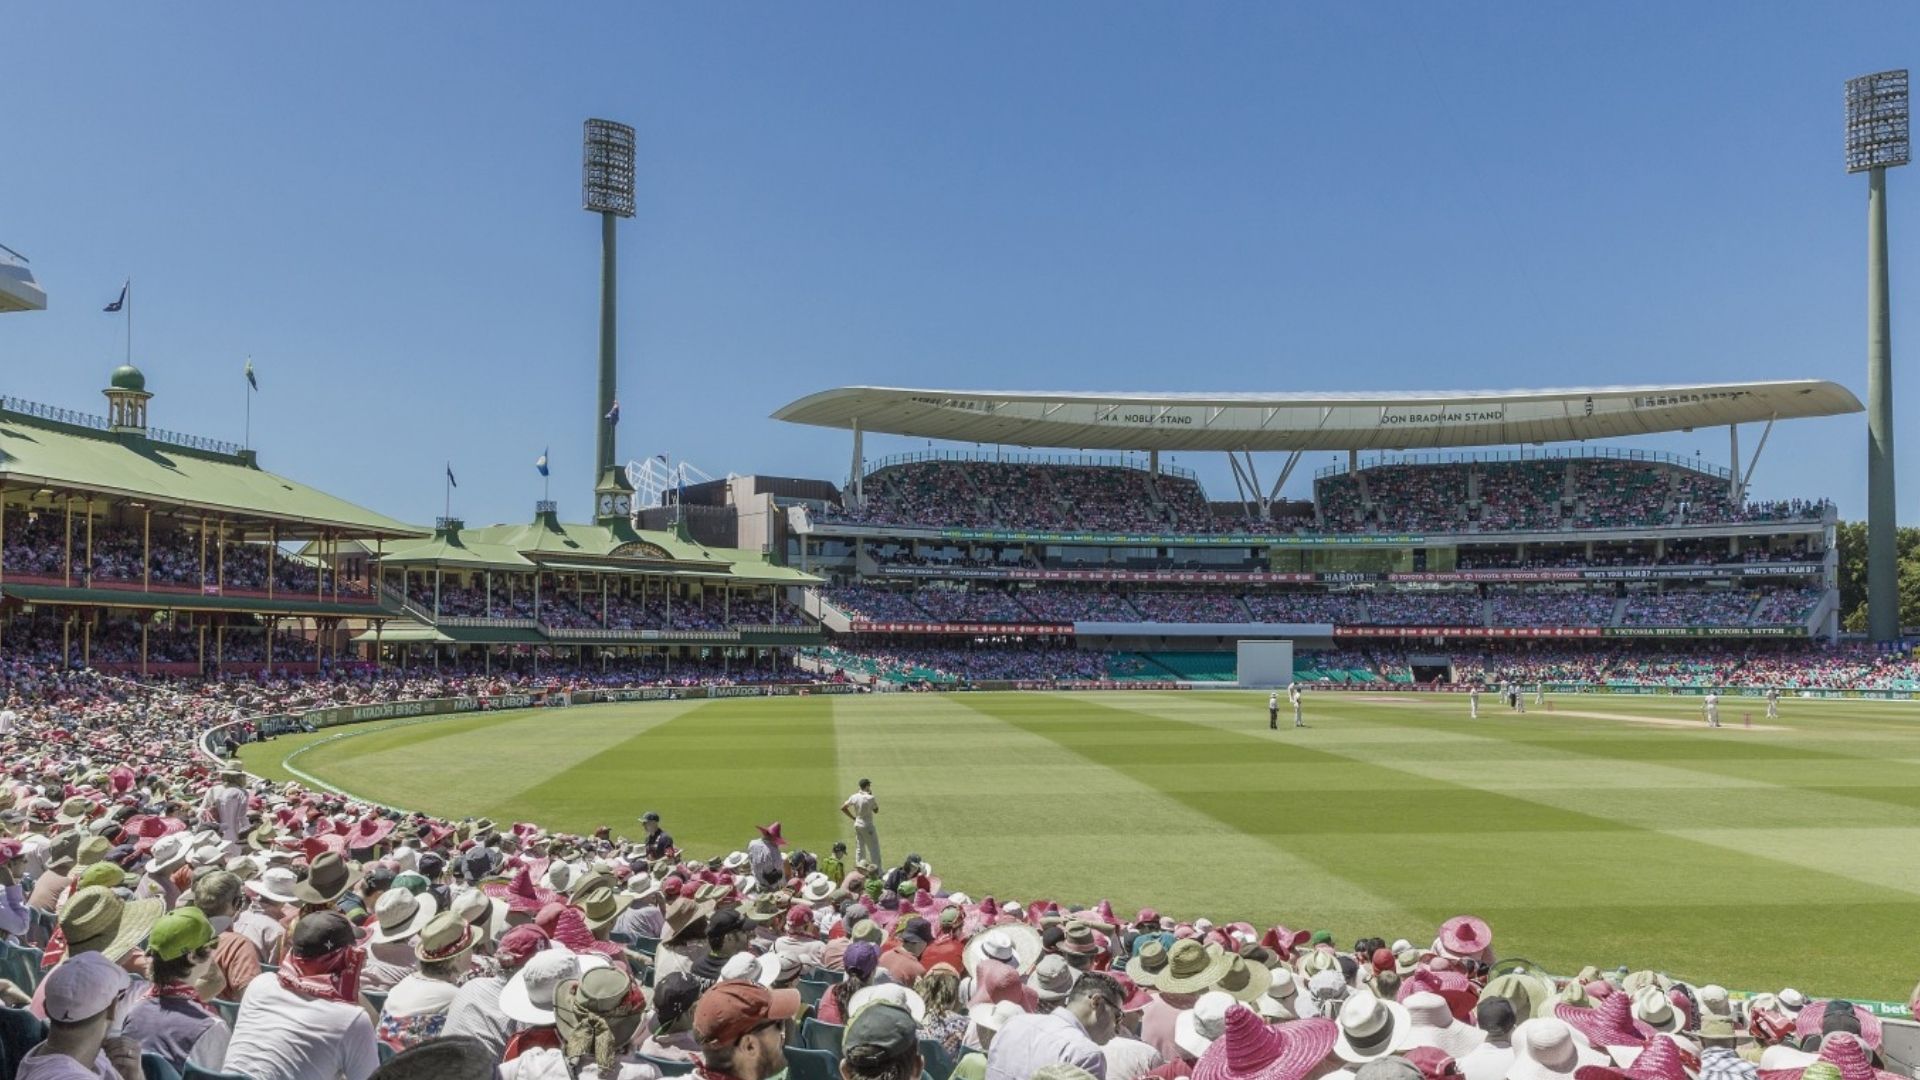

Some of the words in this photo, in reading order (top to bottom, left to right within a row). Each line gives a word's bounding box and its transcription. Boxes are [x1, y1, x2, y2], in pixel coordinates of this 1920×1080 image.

[1160, 415, 1192, 425] STAND
[1381, 415, 1406, 424] DON
[1465, 411, 1502, 421] STAND
[1324, 573, 1364, 581] HARDYS
